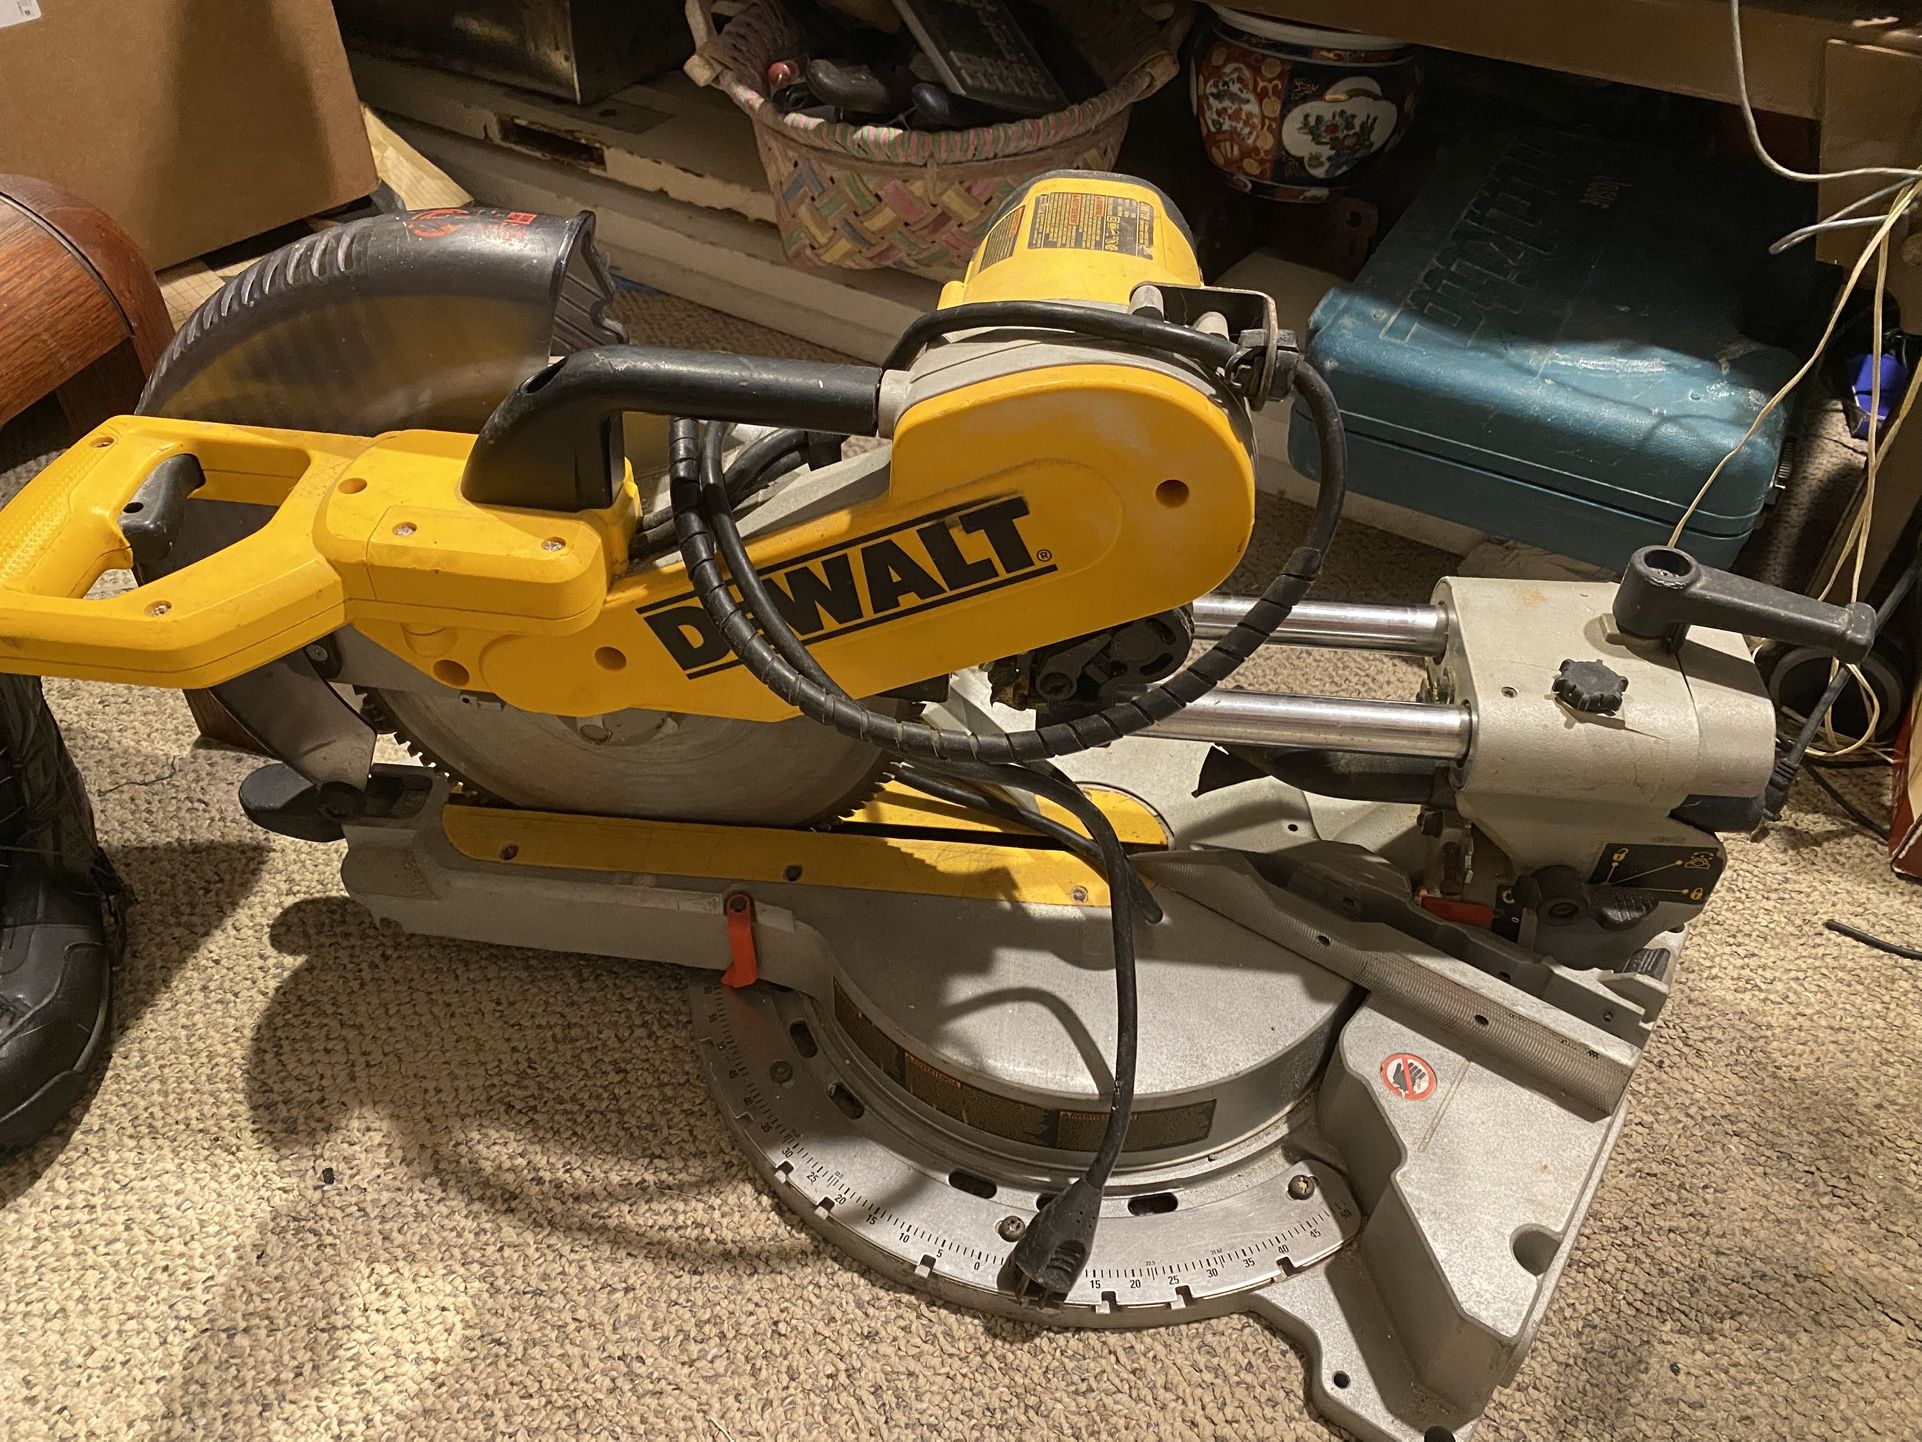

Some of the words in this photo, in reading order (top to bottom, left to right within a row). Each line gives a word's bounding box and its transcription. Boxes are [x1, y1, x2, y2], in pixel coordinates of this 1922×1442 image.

[643, 496, 1034, 671] DWALT
[781, 1147, 794, 1158] 30
[806, 1171, 819, 1183] 25
[834, 1193, 847, 1206] 20
[866, 1214, 877, 1225] 15
[899, 1232, 910, 1244] 10
[1309, 1228, 1322, 1239] 45
[936, 1249, 943, 1258] 5
[1277, 1244, 1290, 1255] 40
[973, 1261, 981, 1271] 0
[1242, 1257, 1256, 1269] 35
[1206, 1267, 1219, 1279] 30
[1090, 1279, 1101, 1289] 15
[1130, 1279, 1141, 1289] 20
[1167, 1274, 1180, 1286] 25
